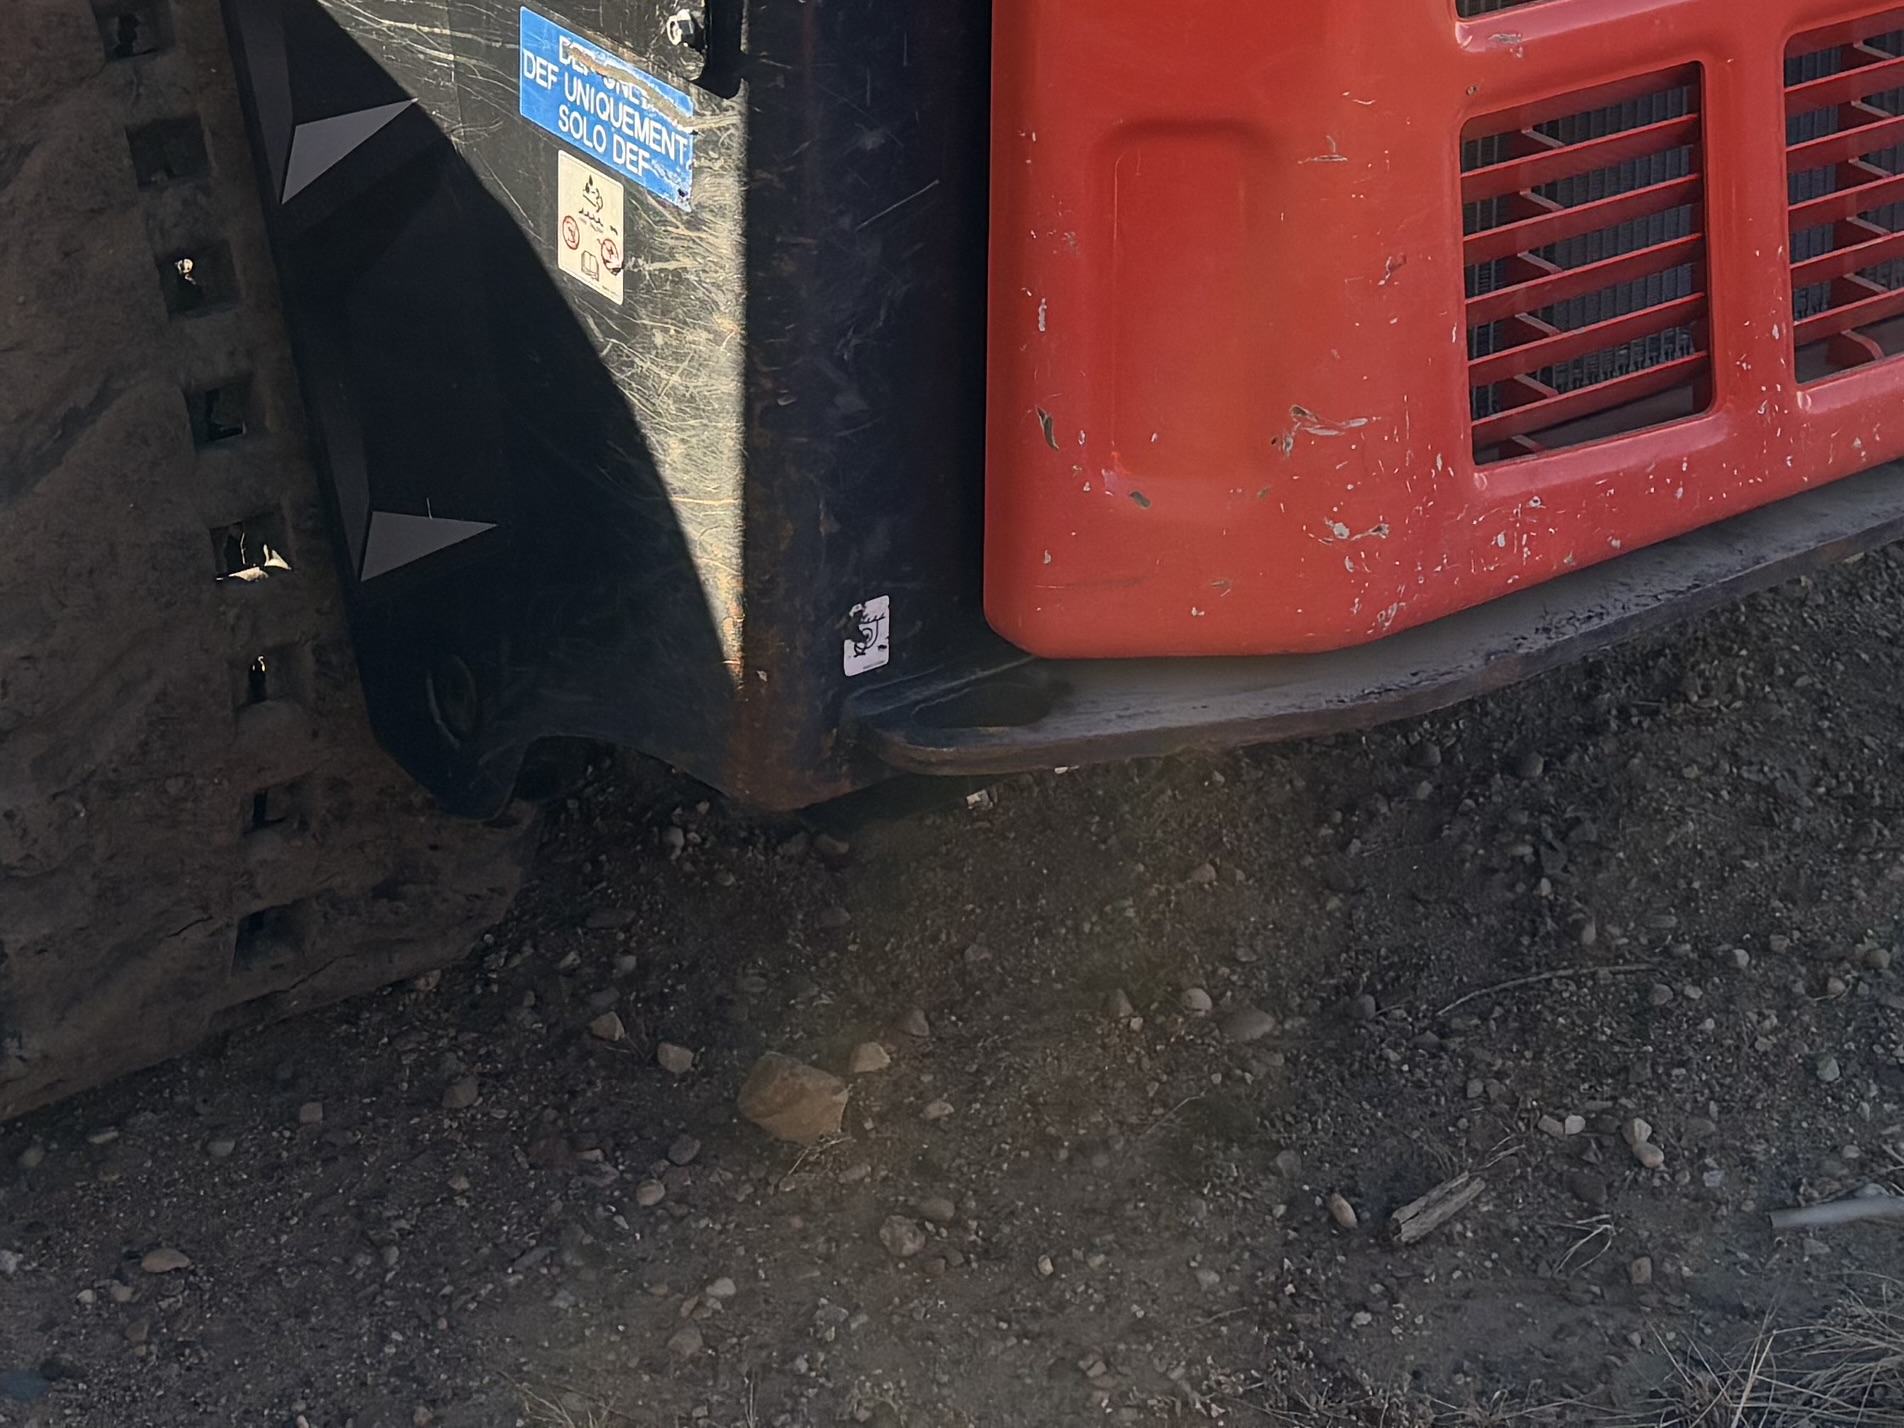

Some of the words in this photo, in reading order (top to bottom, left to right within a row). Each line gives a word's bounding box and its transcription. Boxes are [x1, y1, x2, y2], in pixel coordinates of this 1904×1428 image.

[522, 48, 560, 90] DEF
[564, 72, 688, 166] UNIQUEMENT
[558, 104, 607, 154] SOLO
[613, 133, 651, 177] DEF
